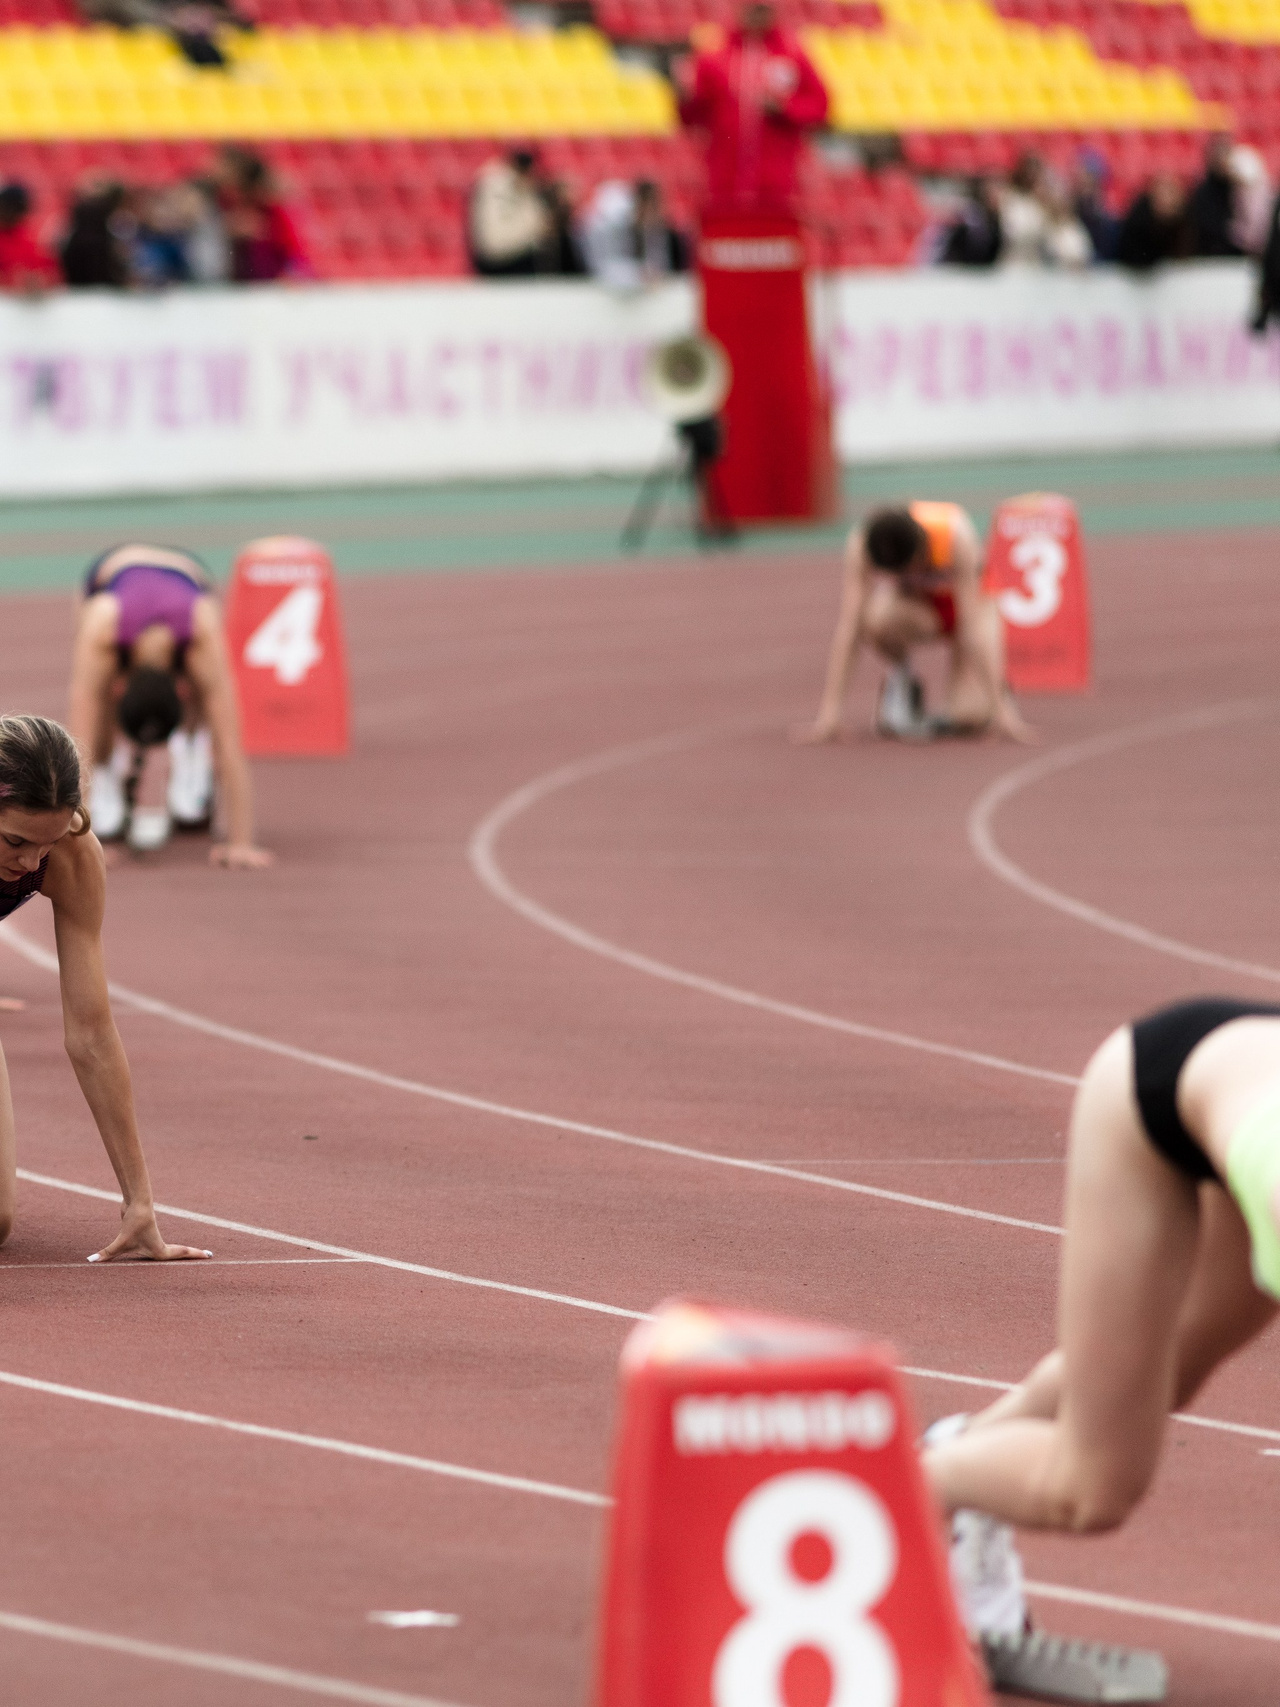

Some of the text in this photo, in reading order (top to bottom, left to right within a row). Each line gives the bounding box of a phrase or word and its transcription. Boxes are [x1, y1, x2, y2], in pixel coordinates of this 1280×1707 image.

[998, 533, 1067, 627] 3
[243, 587, 324, 686] 4
[673, 1391, 894, 1455] MONDO
[711, 1467, 900, 1707] 8
